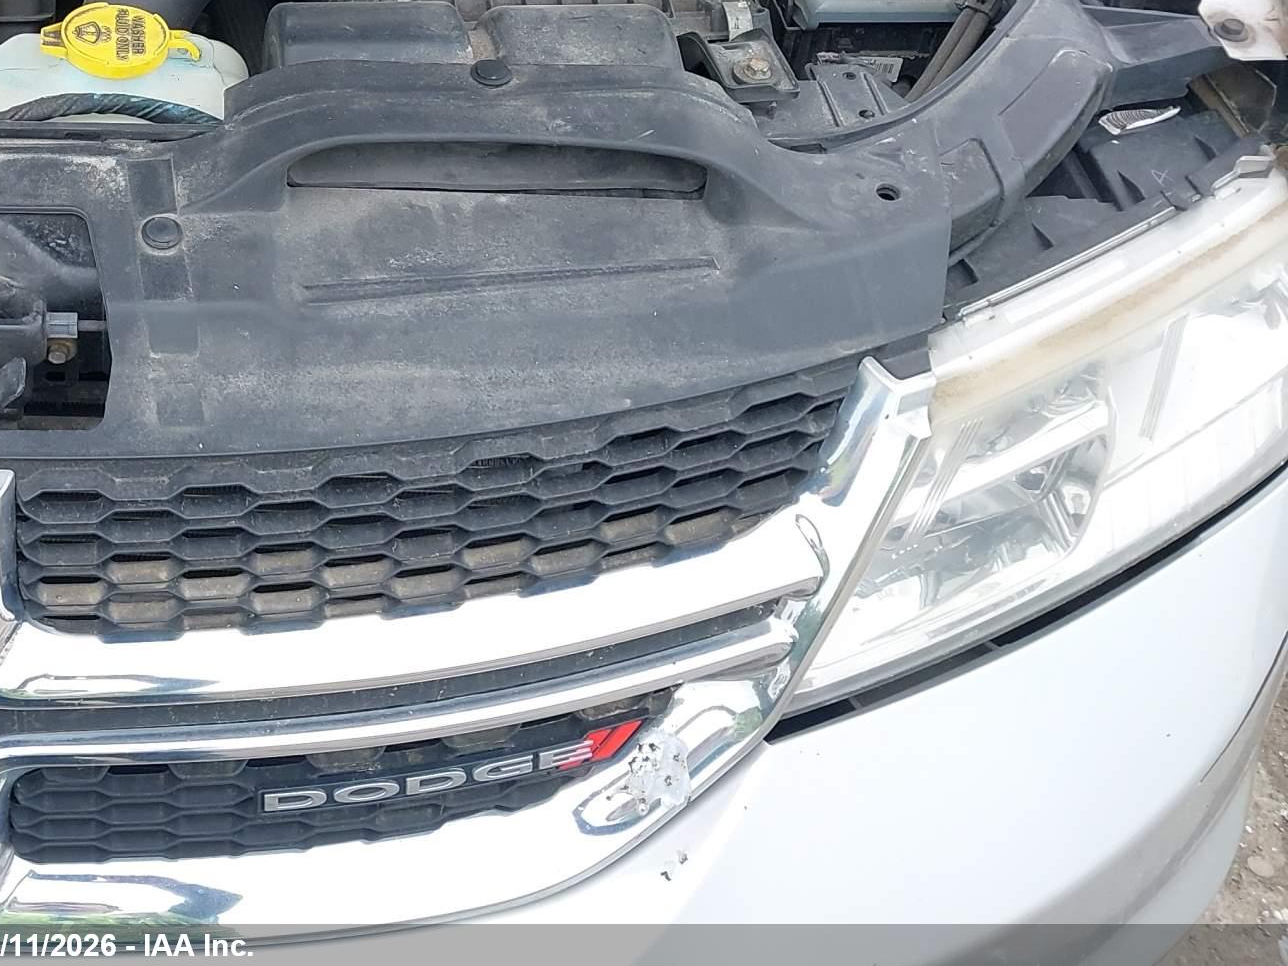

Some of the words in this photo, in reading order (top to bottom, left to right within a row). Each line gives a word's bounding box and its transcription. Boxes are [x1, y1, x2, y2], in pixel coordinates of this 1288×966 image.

[115, 36, 130, 62] ONLY
[131, 15, 145, 55] WASHER
[263, 738, 593, 813] DODGE
